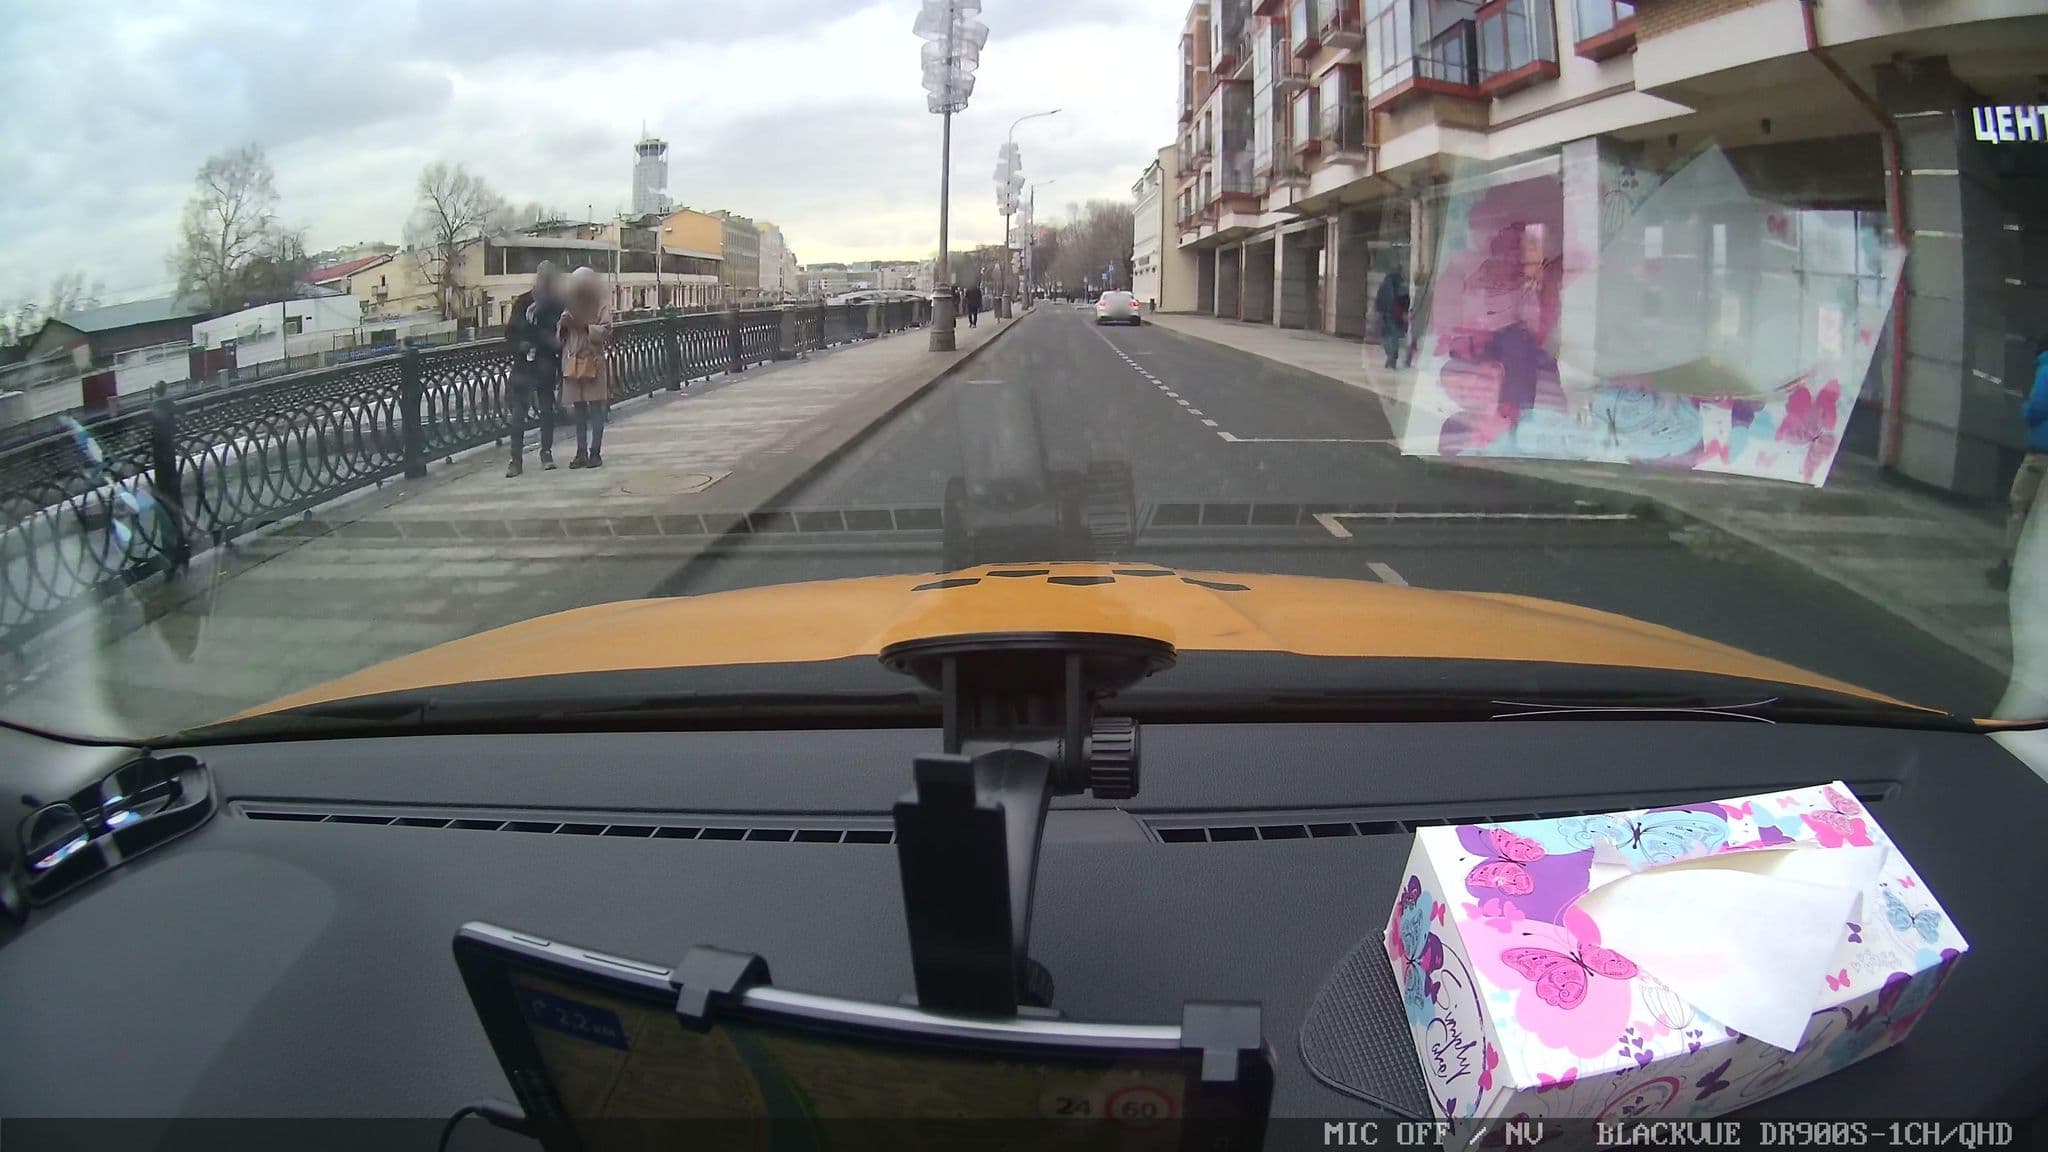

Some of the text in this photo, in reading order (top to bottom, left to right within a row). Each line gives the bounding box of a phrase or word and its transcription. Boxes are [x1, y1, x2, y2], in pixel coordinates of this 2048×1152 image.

[1436, 969, 1477, 1084] Simply
[1055, 1097, 1090, 1115] 24
[1121, 1101, 1158, 1119] 60
